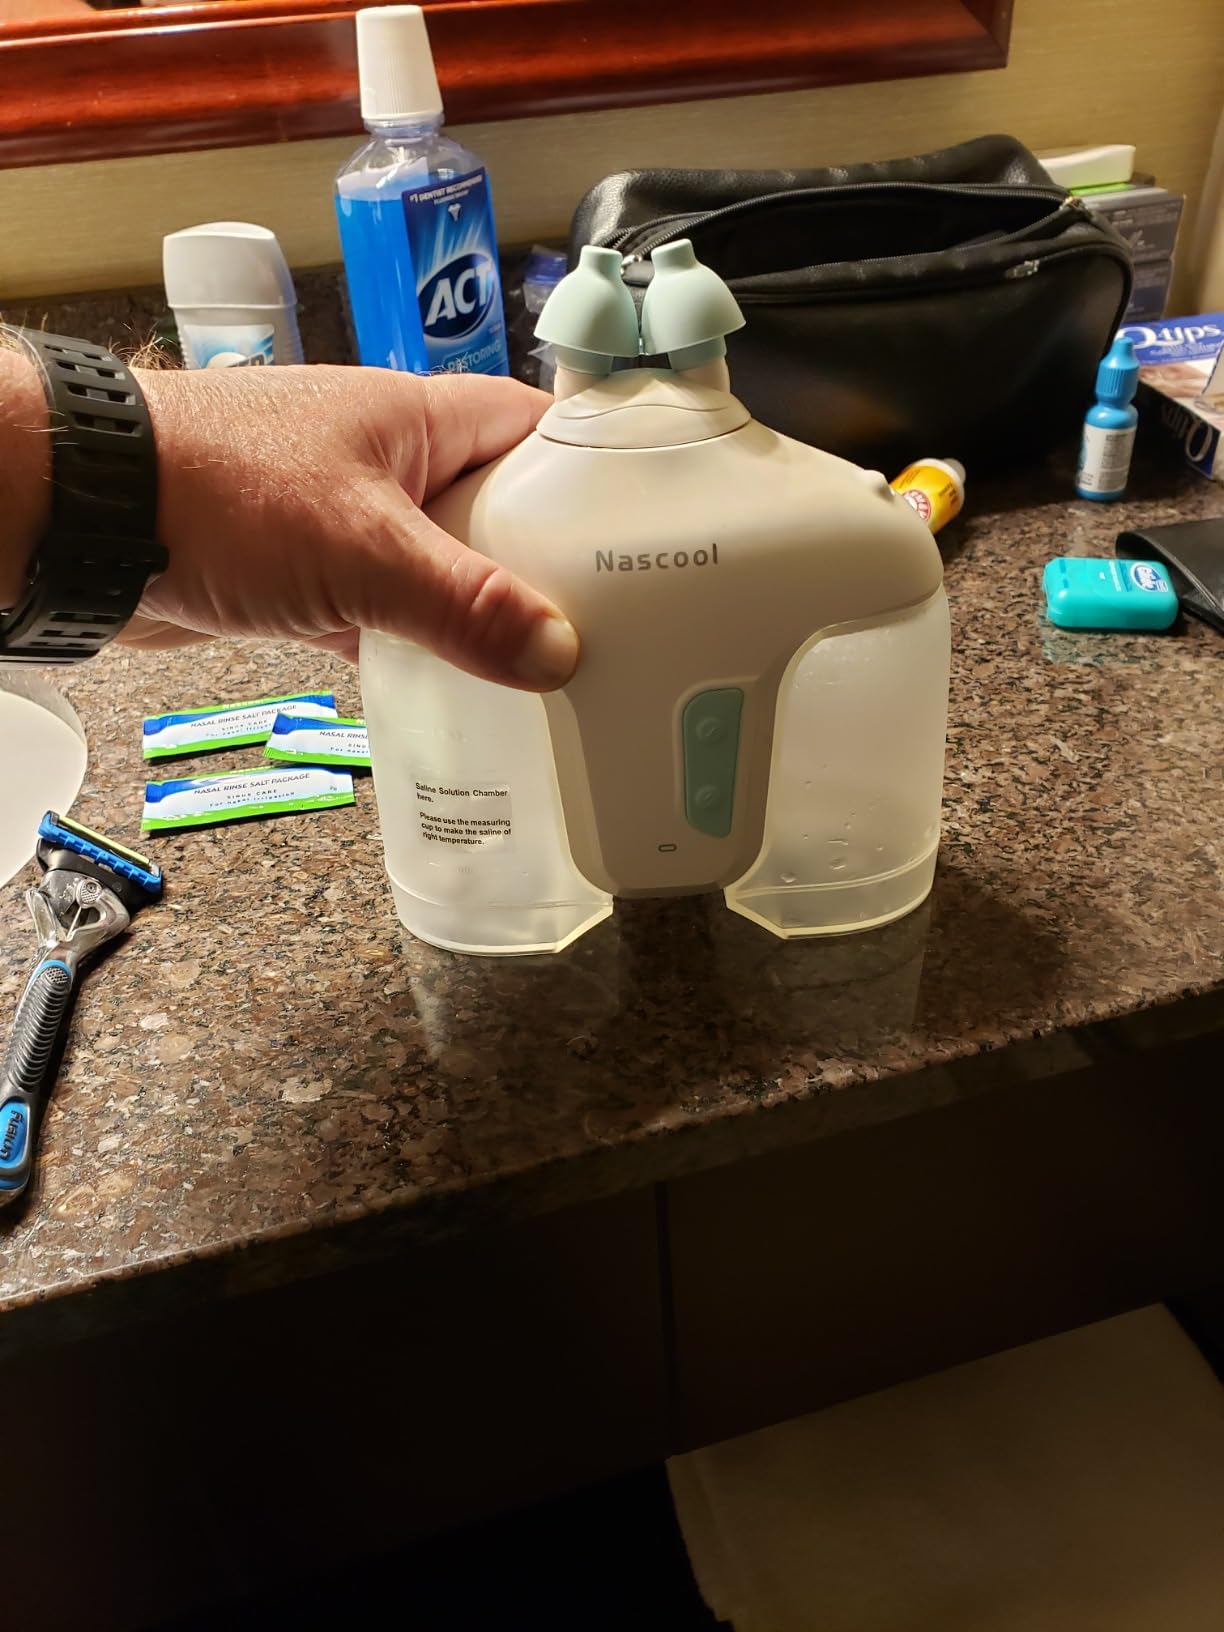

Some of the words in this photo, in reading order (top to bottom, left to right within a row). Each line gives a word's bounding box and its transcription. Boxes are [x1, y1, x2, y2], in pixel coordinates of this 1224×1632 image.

[424, 264, 492, 327] ACT
[595, 543, 719, 572] Nascool
[191, 720, 216, 728] NASAL
[218, 716, 240, 724] RINSE
[242, 712, 260, 720] SALT
[261, 705, 297, 716] PACKAGE
[319, 731, 345, 739] NASAL
[194, 787, 221, 795] NASAL
[223, 783, 247, 791] RINSE
[250, 779, 269, 788] SALT
[271, 773, 310, 784] PACKAGE
[416, 782, 436, 793] Saline
[439, 787, 470, 796] Solution
[473, 789, 508, 797] Chamber
[417, 792, 434, 803] here.
[420, 811, 441, 822] Please
[457, 818, 469, 826] the
[471, 819, 511, 827] measuring
[421, 822, 433, 831] cup
[435, 824, 442, 832] to
[444, 827, 463, 835] make
[465, 828, 477, 836] the
[479, 828, 502, 836] saline
[504, 828, 512, 836] of
[422, 831, 438, 841] right
[439, 834, 485, 845] temperature.
